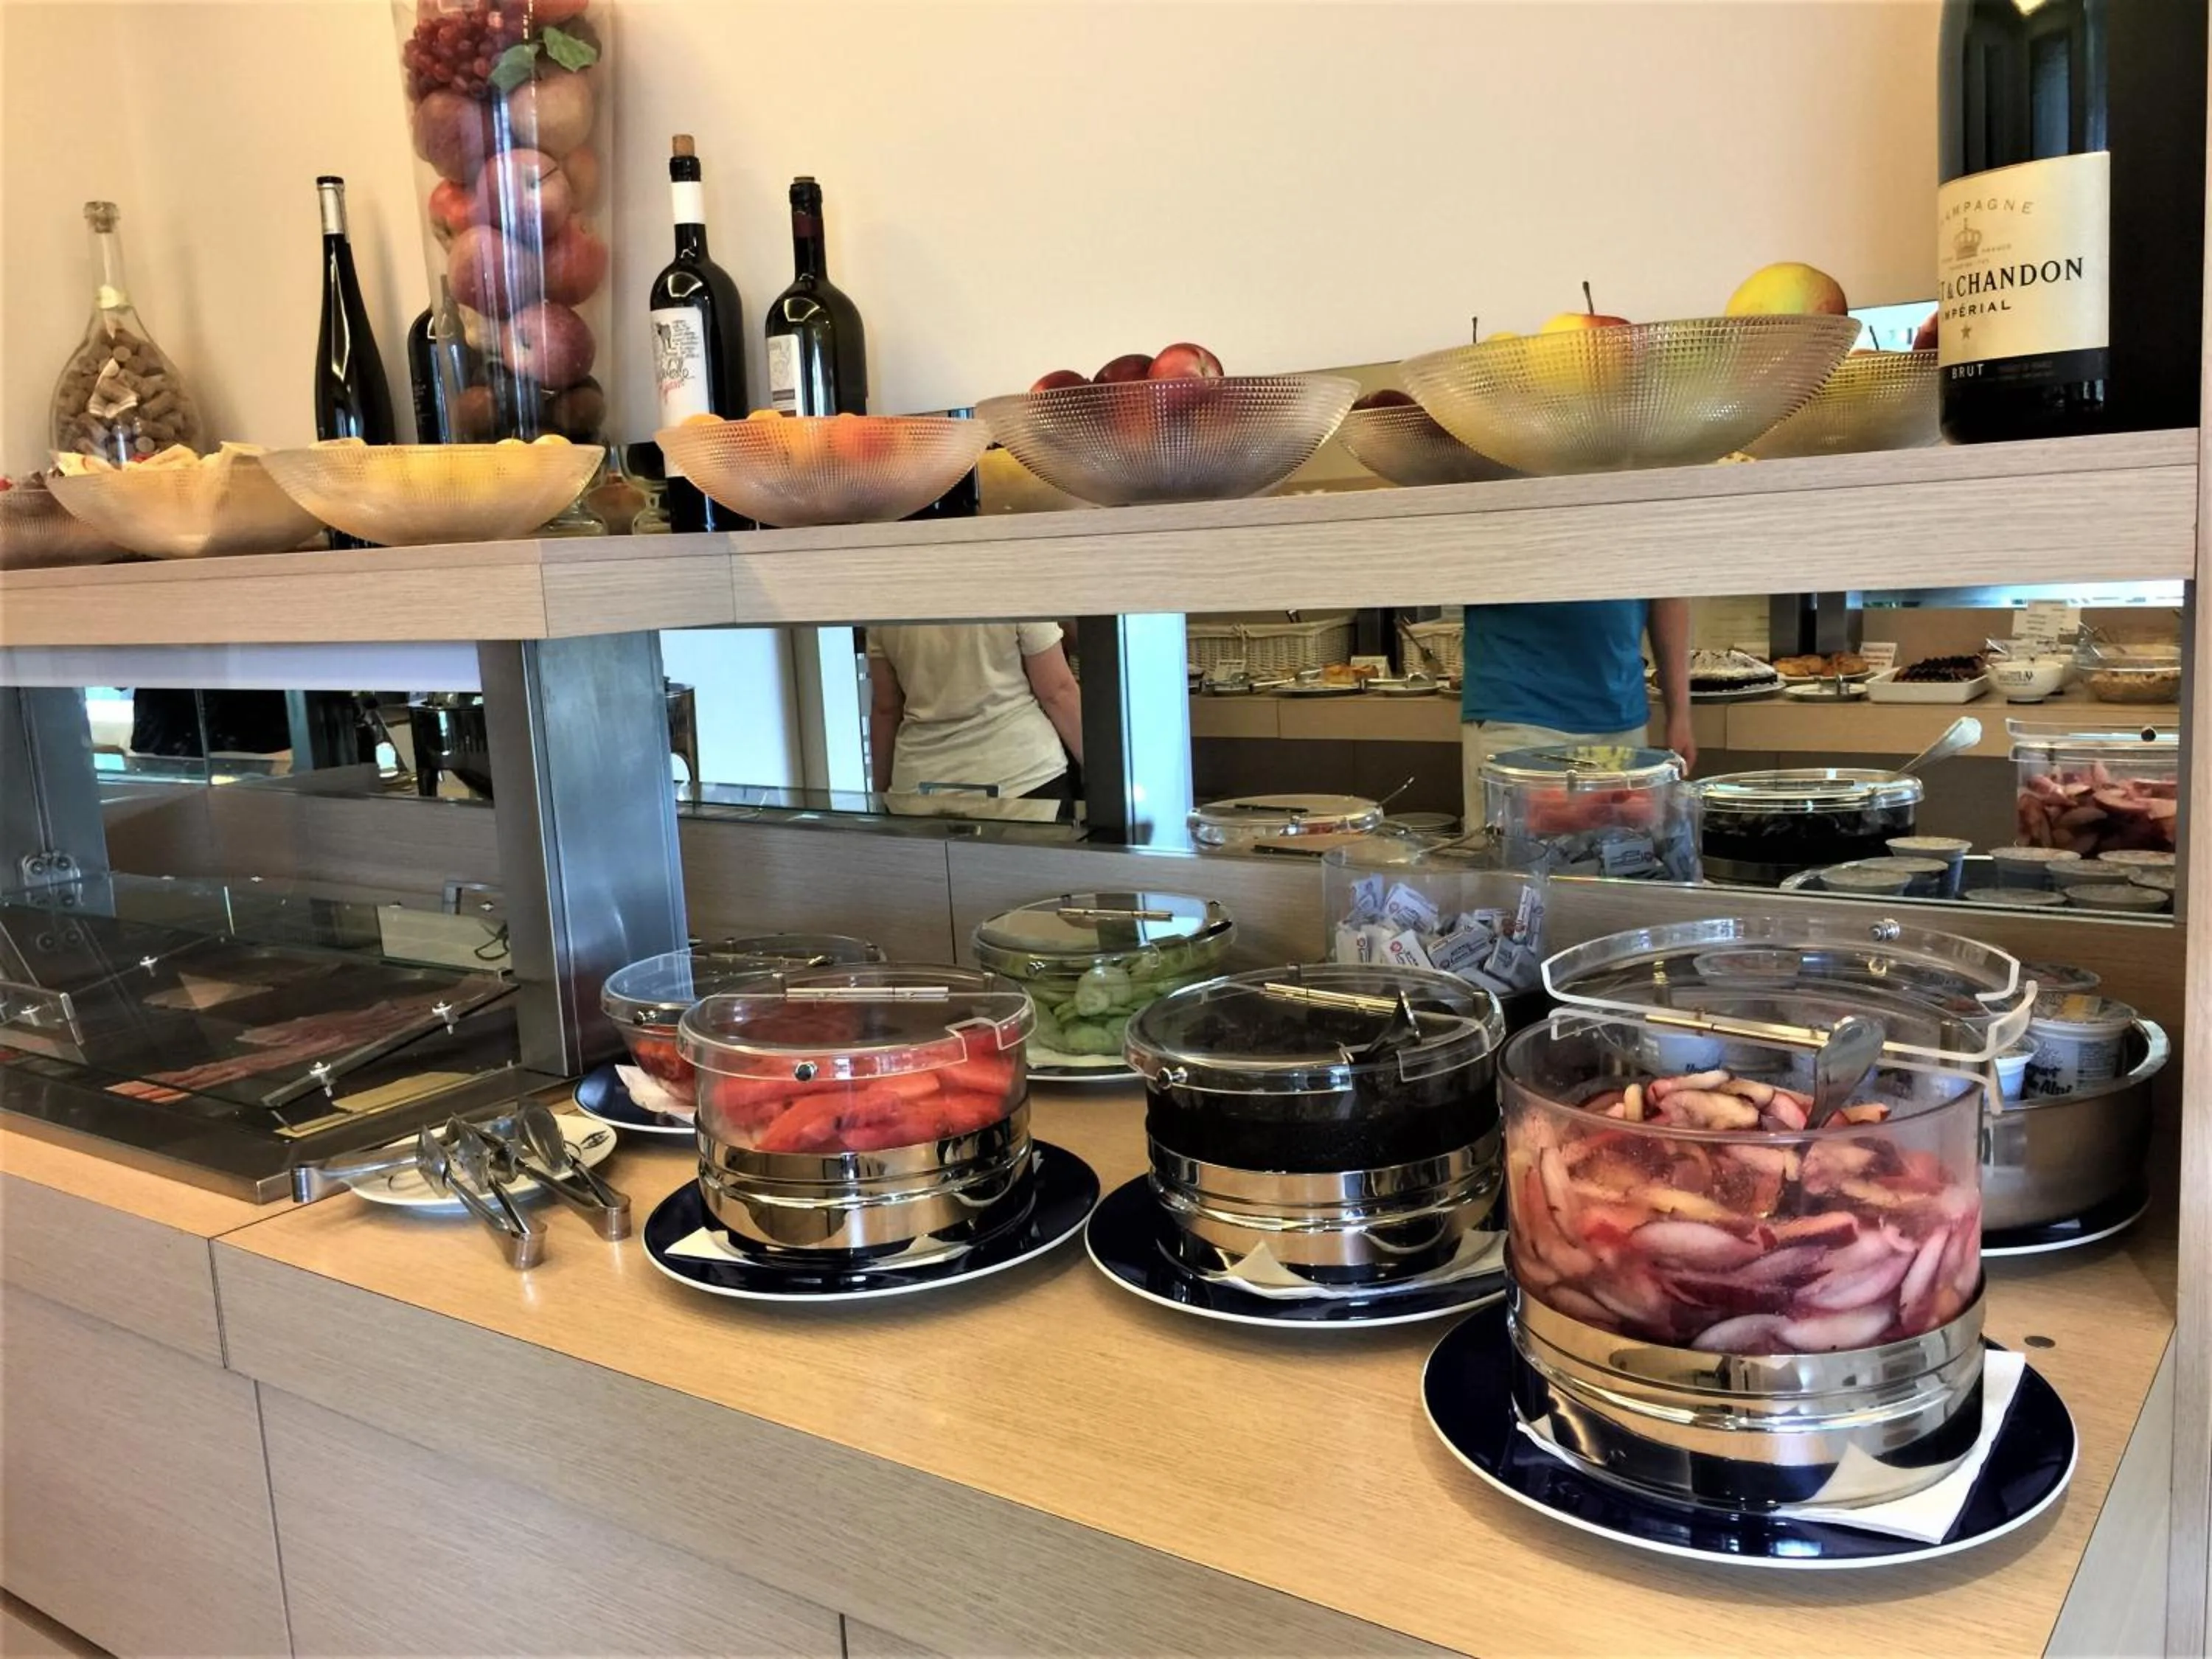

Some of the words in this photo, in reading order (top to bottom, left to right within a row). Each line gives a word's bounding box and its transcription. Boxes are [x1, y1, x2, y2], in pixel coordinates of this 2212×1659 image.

[1944, 198, 2034, 221] AMPAGNE
[1956, 257, 2084, 296] CHANDON
[1952, 363, 1985, 380] BRUT
